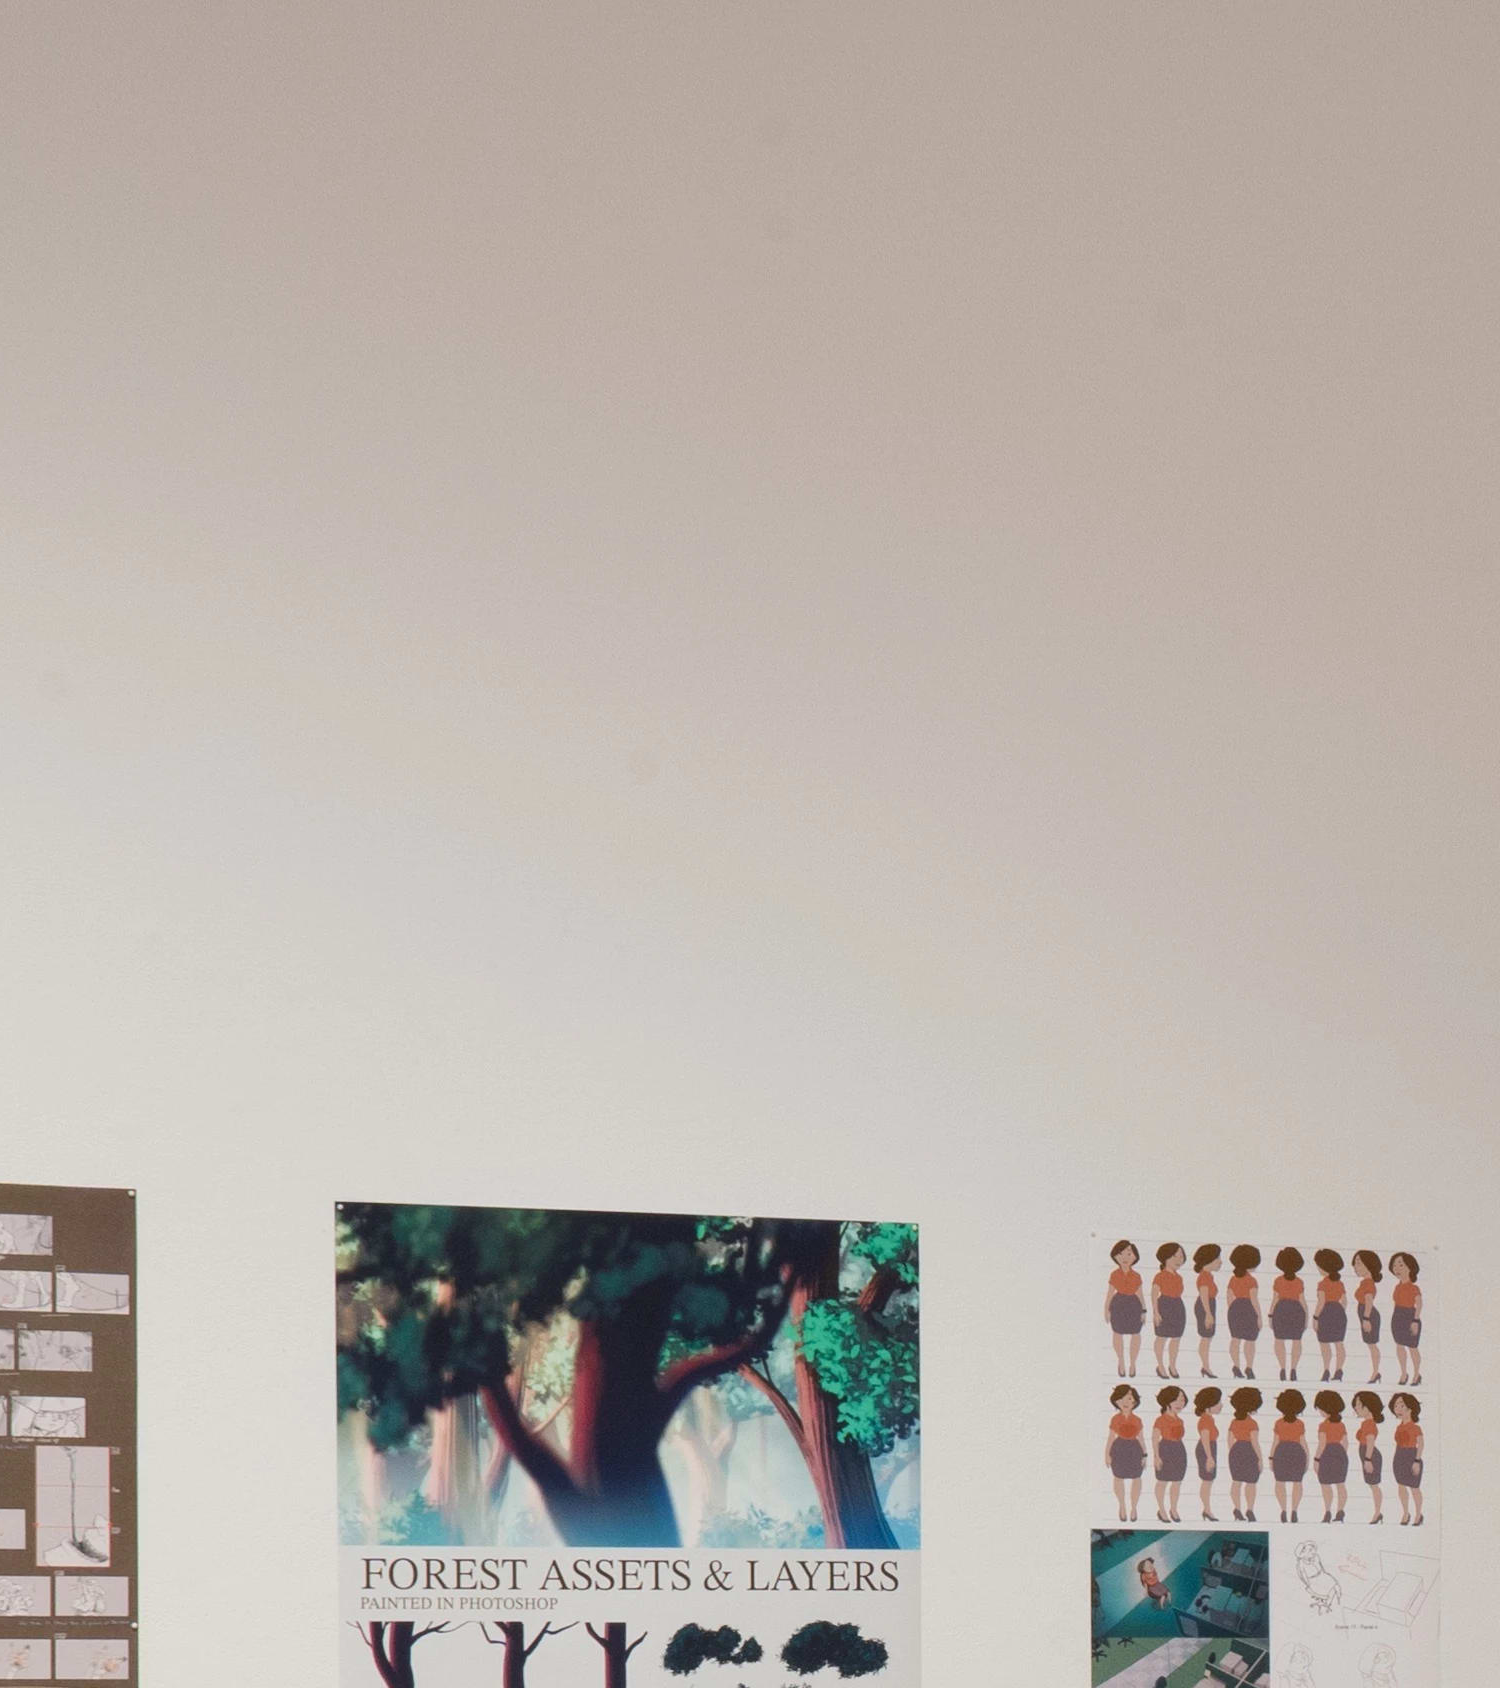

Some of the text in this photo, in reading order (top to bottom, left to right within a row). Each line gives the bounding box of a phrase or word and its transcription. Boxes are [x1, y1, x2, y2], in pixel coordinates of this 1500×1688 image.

[361, 1557, 900, 1592] FOREST ASSETS & LAYERS
[360, 1596, 558, 1610] PAINTED IN PHOTOSHOP
